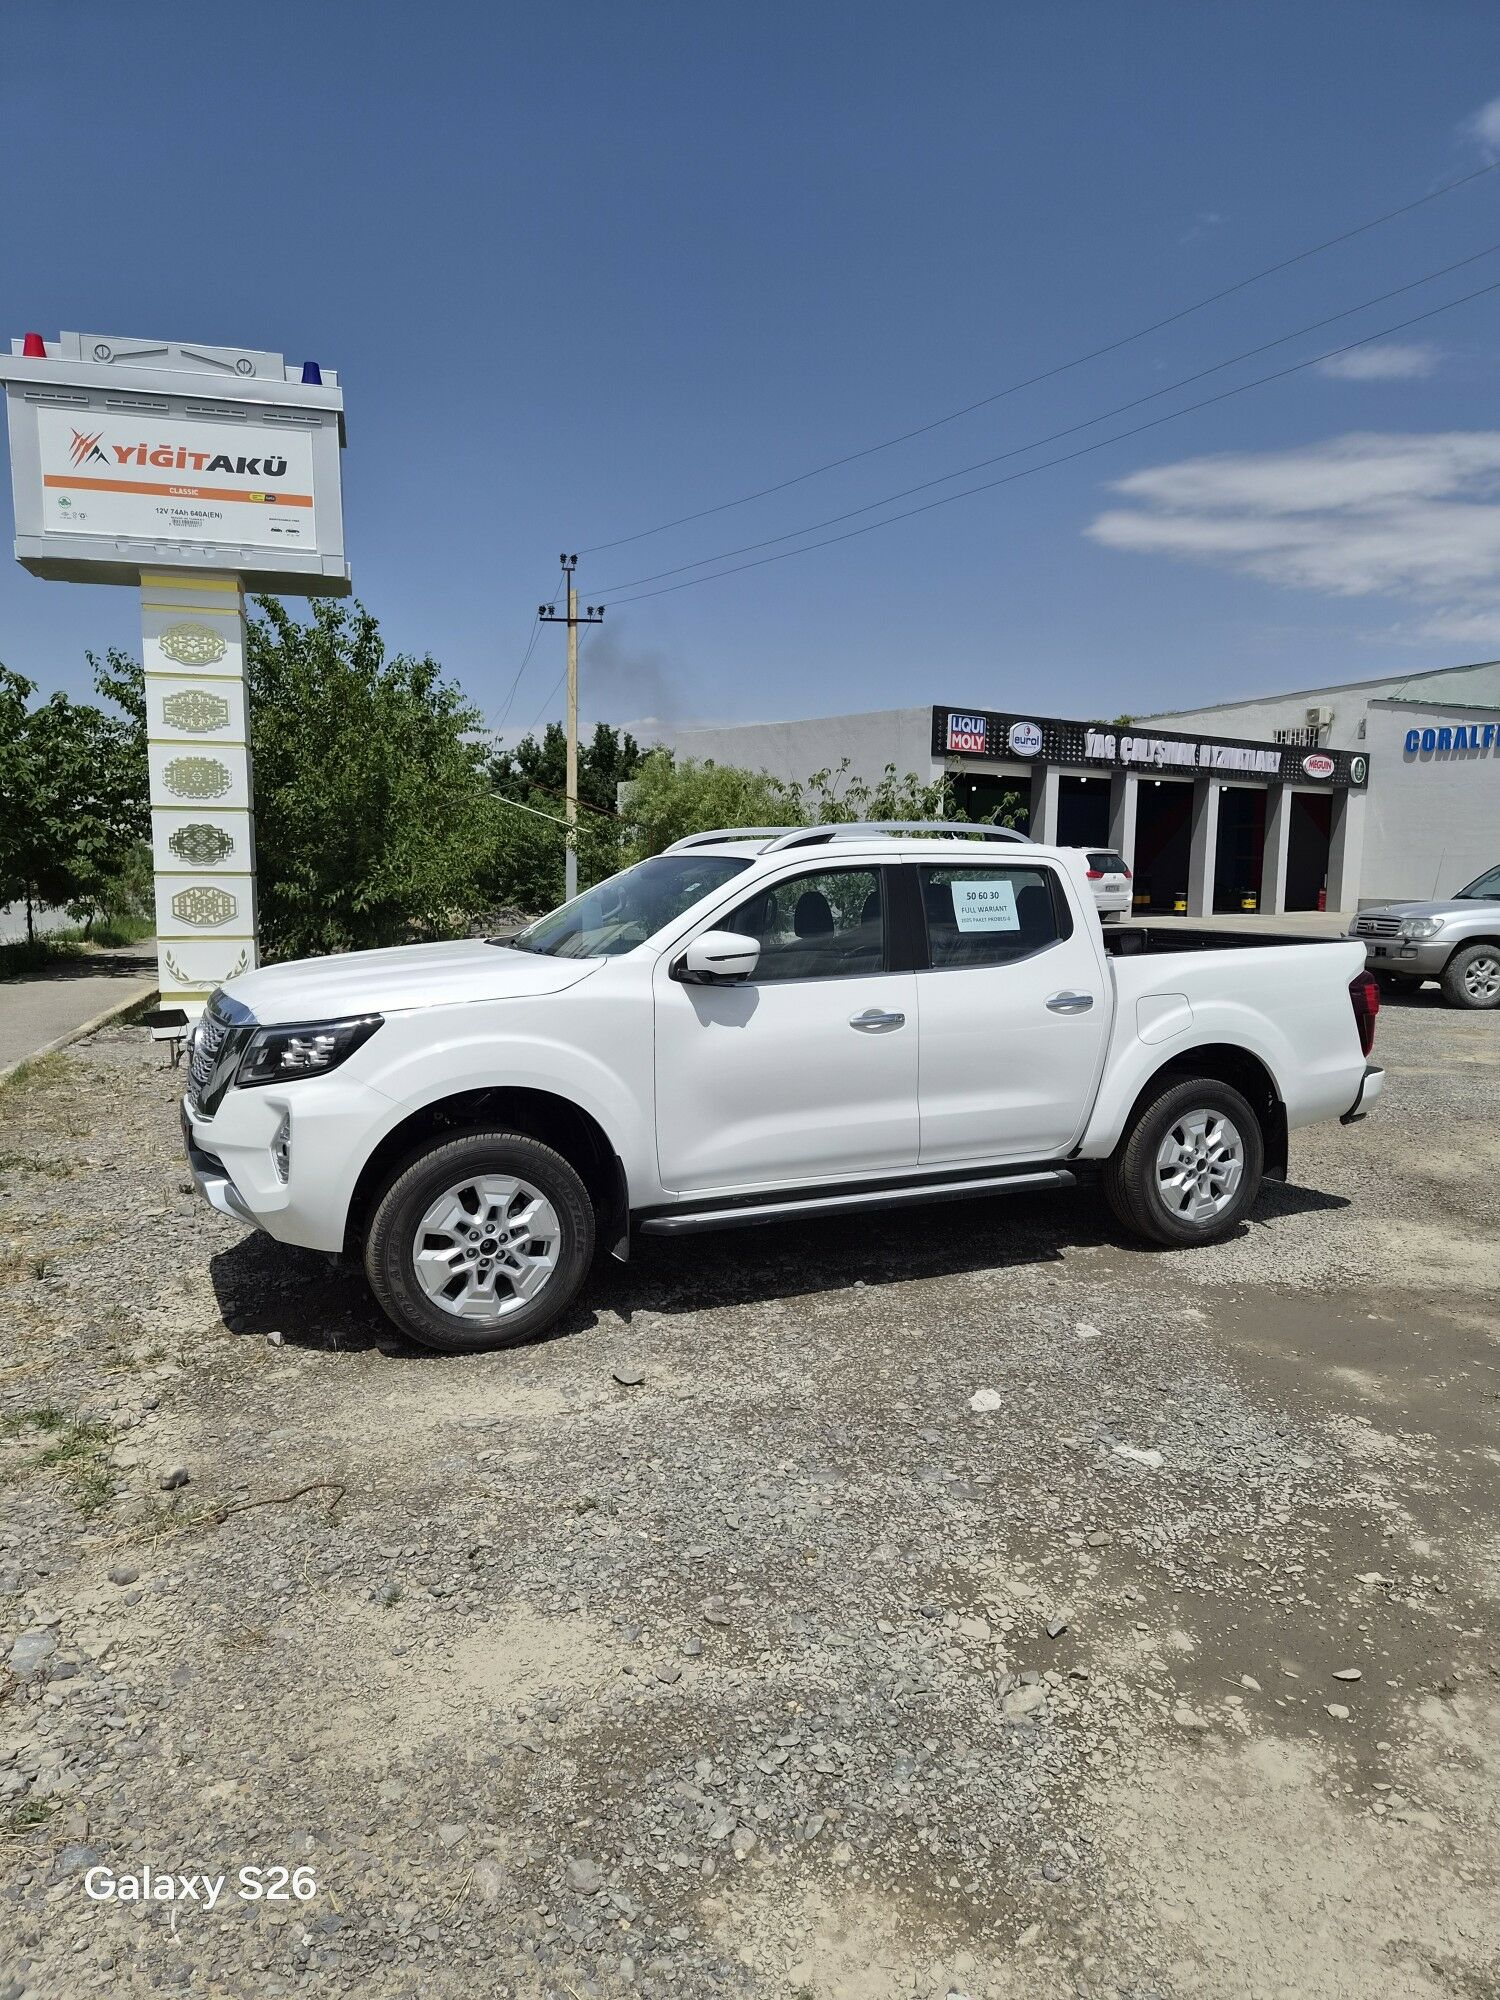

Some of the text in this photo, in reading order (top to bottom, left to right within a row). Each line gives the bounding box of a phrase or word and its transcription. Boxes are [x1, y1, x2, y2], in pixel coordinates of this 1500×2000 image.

[112, 443, 288, 477] YİĞİTAKÜ
[169, 487, 199, 496] CLASSIC
[155, 507, 169, 515] 12V
[170, 508, 189, 516] 74Ah
[952, 716, 984, 734] LIQUI
[951, 733, 984, 750] MOLY
[1014, 735, 1040, 746] eurol
[1404, 724, 1500, 753] CORALF
[1308, 759, 1332, 770] MEGUIN
[966, 891, 1000, 901] 50 60 30
[977, 905, 1008, 913] WARIANT
